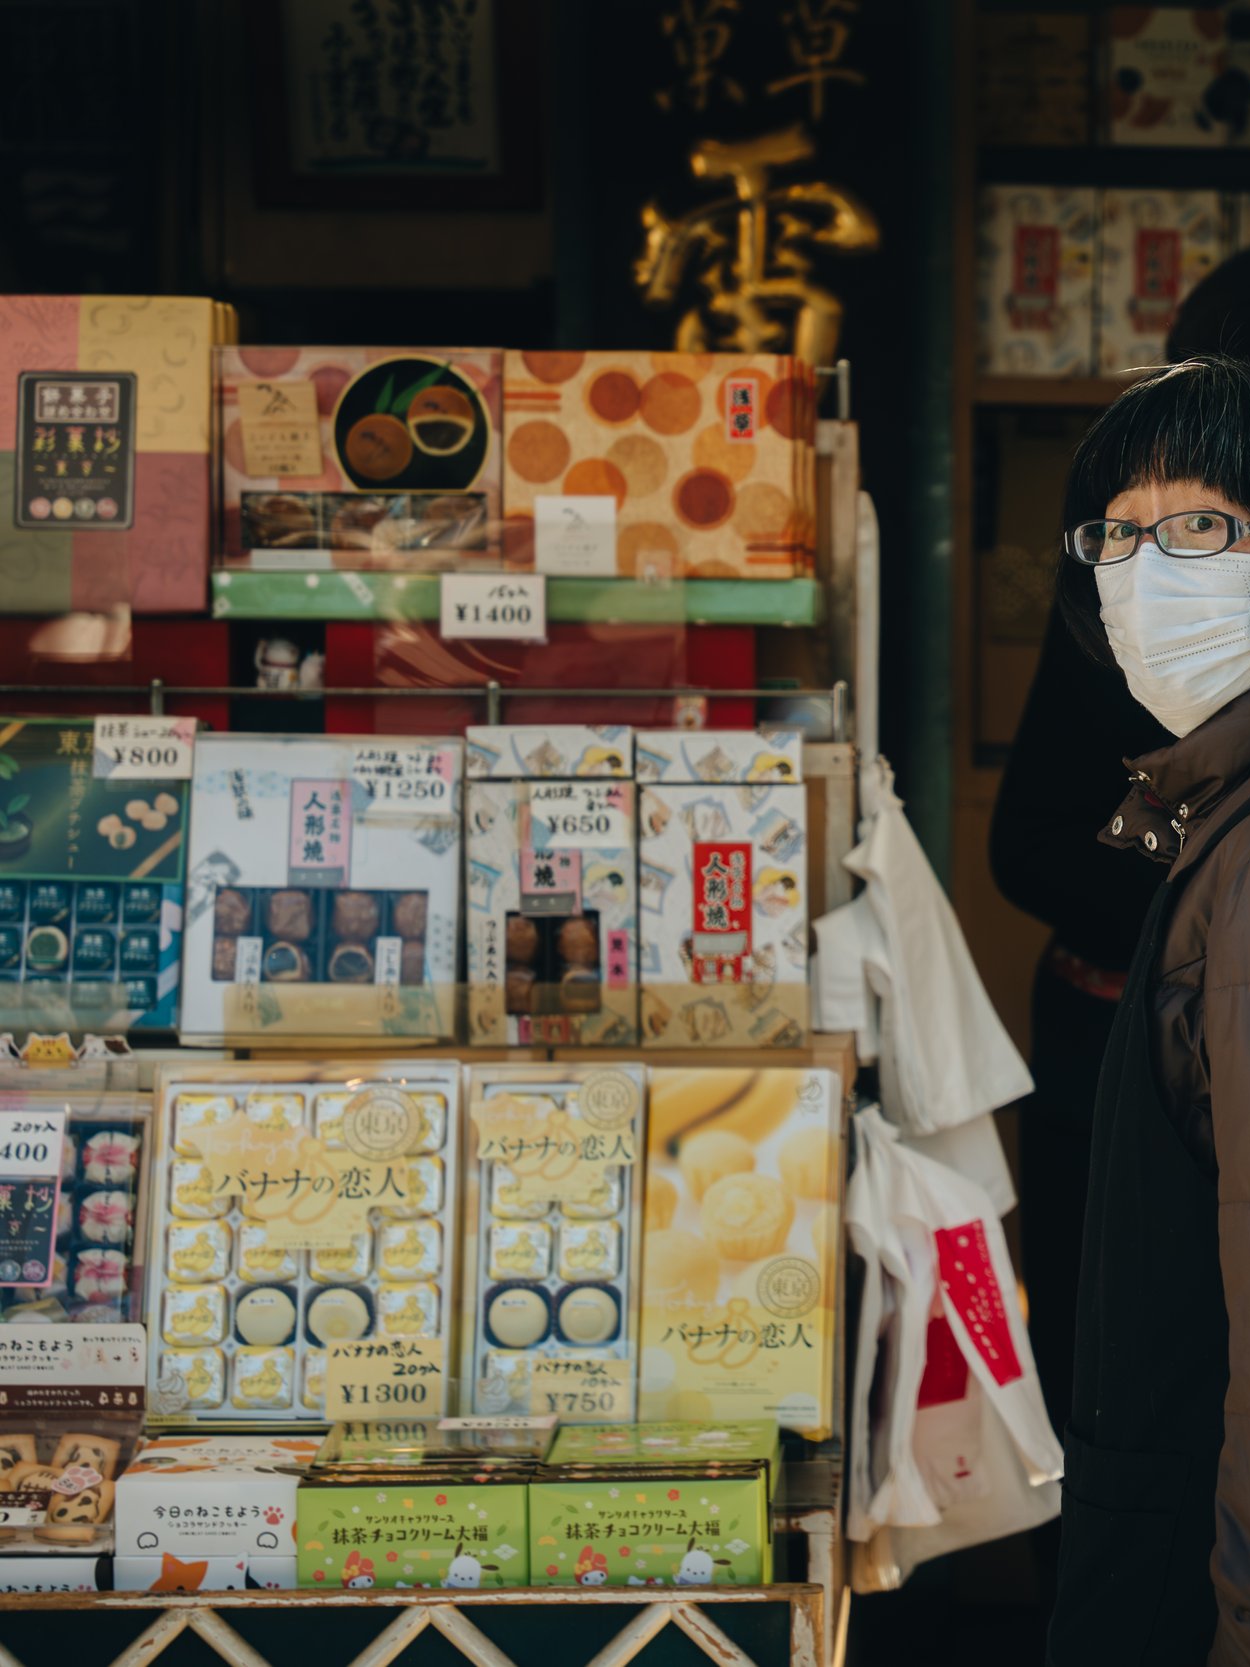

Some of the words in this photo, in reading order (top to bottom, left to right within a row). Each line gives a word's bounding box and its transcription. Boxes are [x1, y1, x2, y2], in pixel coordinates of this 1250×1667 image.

[455, 603, 532, 624] ¥1400
[112, 746, 178, 766] ¥800
[366, 779, 445, 798] ¥1250
[302, 790, 326, 863] 人形焼
[547, 813, 611, 834] ¥650
[703, 852, 730, 930] 人形焼
[483, 1132, 634, 1161] バナナの恋人
[215, 1166, 406, 1201] バナナの恋人
[660, 1321, 814, 1350] バナナの恋人
[332, 1341, 423, 1358] バナナの恋人
[535, 1360, 608, 1375] バナナの恋人
[340, 1383, 427, 1404] ¥1300
[545, 1391, 615, 1412] ¥750
[153, 1506, 261, 1519] 今日のねこもよう
[332, 1524, 489, 1545] 抹茶チョコクリーム大福
[565, 1519, 720, 1540] 抹茶チョコクリーム大福
